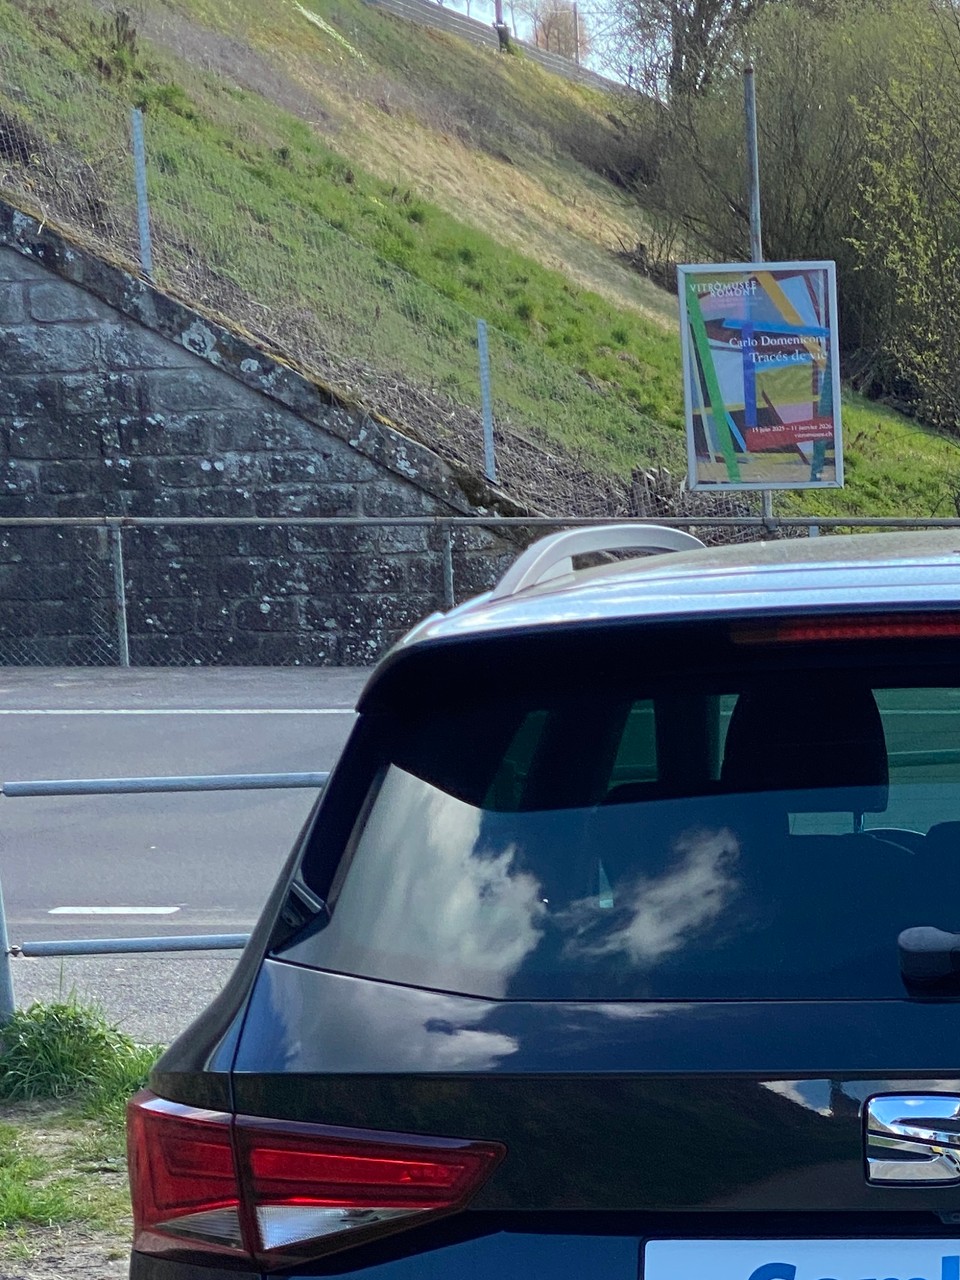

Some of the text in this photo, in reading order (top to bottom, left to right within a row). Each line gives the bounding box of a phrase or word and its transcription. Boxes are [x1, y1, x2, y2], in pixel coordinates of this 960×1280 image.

[710, 286, 757, 298] ROMONT
[729, 333, 826, 347] Carlo Domeniconi
[749, 348, 828, 363] Tracés de vie
